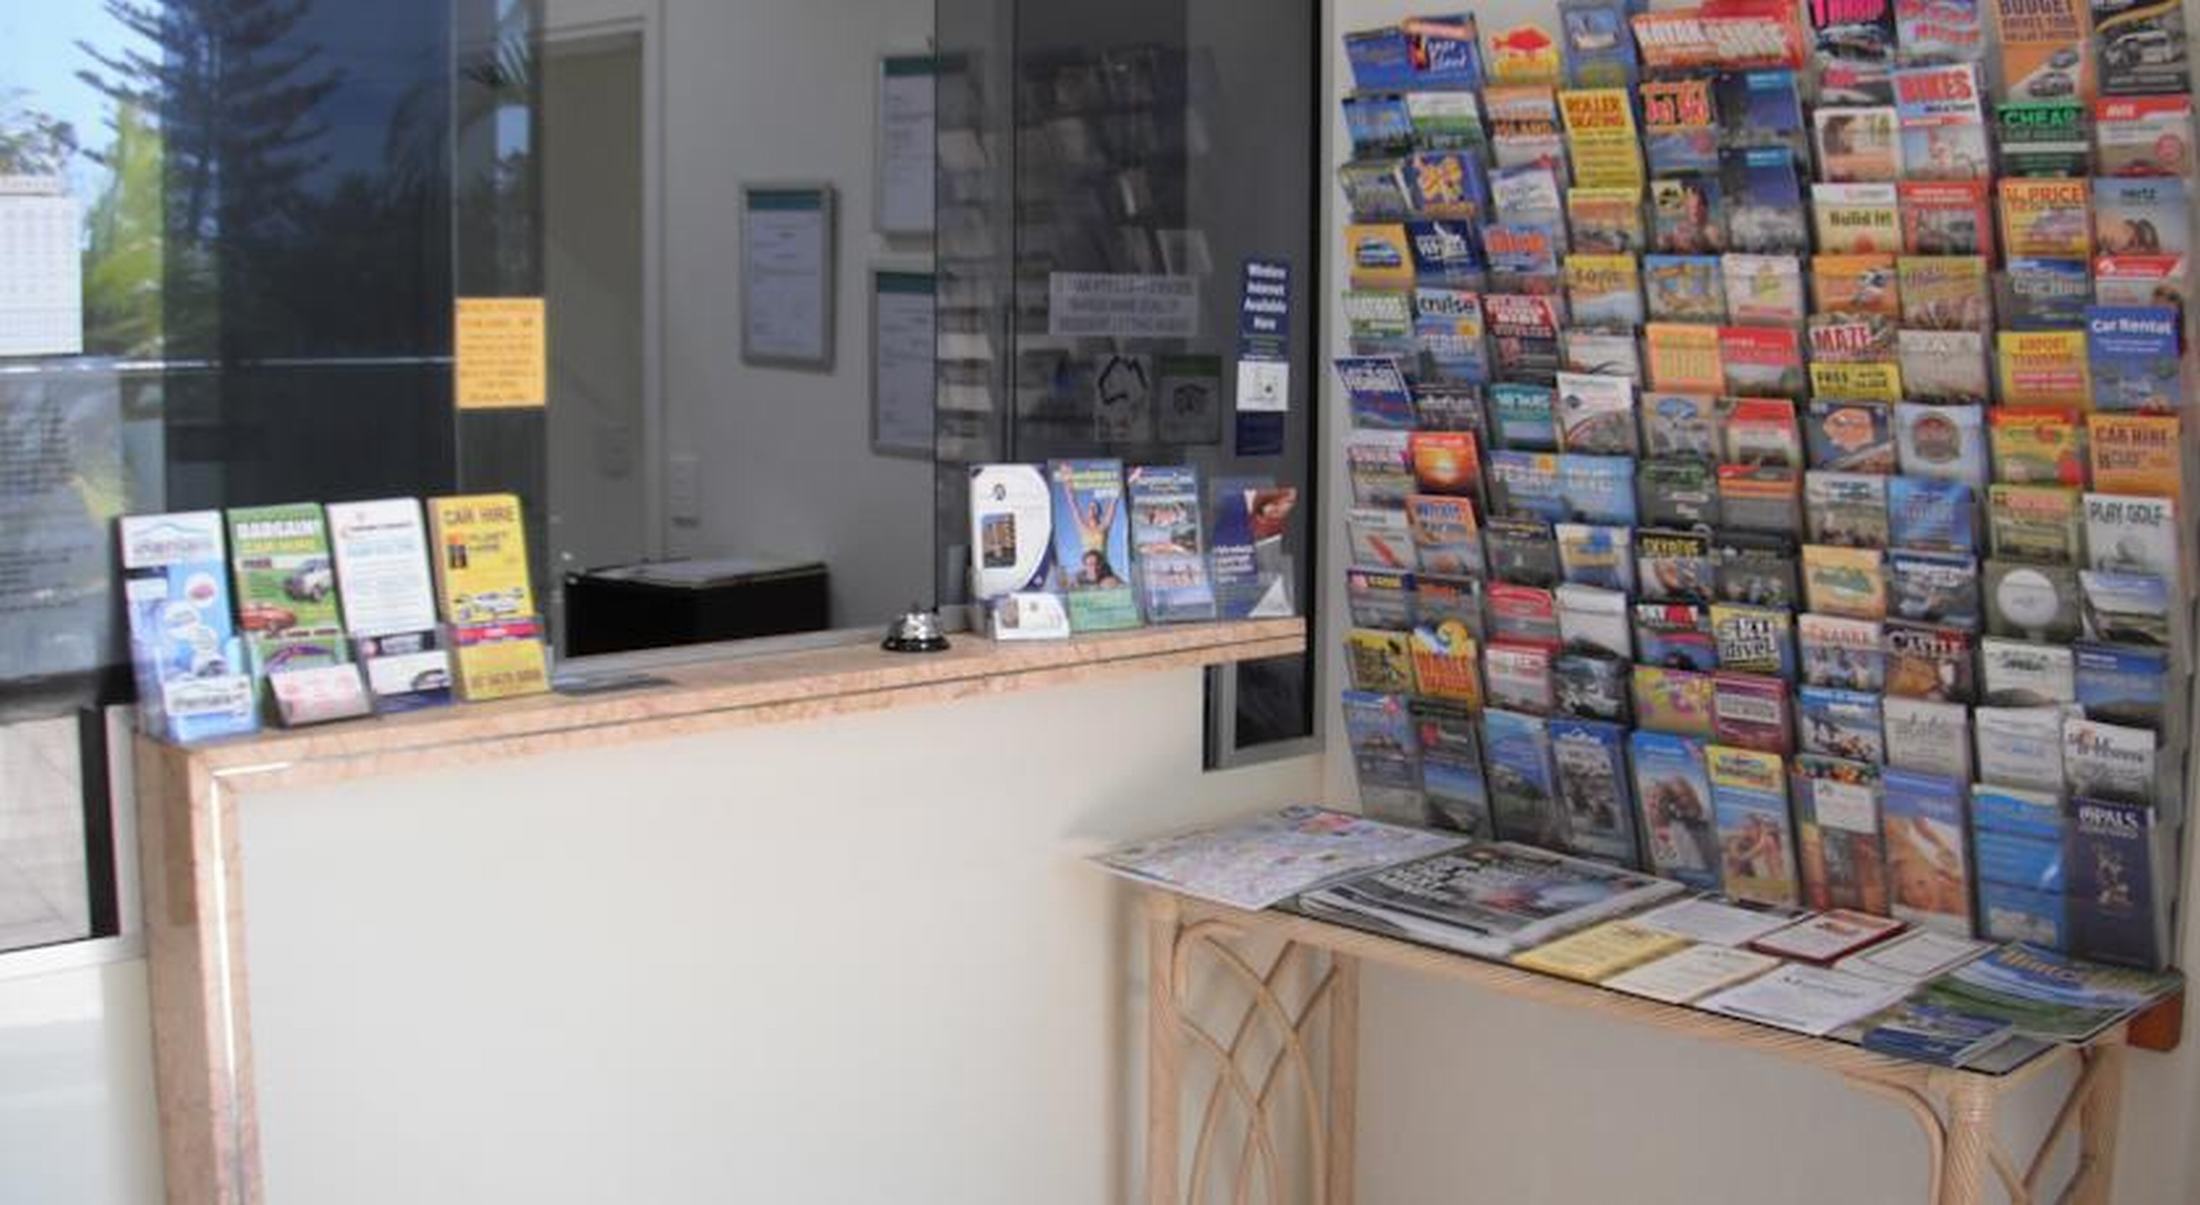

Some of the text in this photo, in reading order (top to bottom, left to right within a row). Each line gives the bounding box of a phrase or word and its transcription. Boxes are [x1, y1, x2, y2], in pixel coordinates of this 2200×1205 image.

[2004, 110, 2077, 127] CHEAP
[1246, 264, 1287, 280] Wireless
[1246, 281, 1286, 297] Internet
[1243, 298, 1288, 314] Available
[2091, 319, 2173, 335] Car Rental
[2090, 501, 2165, 527] PLAY GOLF
[1890, 632, 1963, 655] CASTLE
